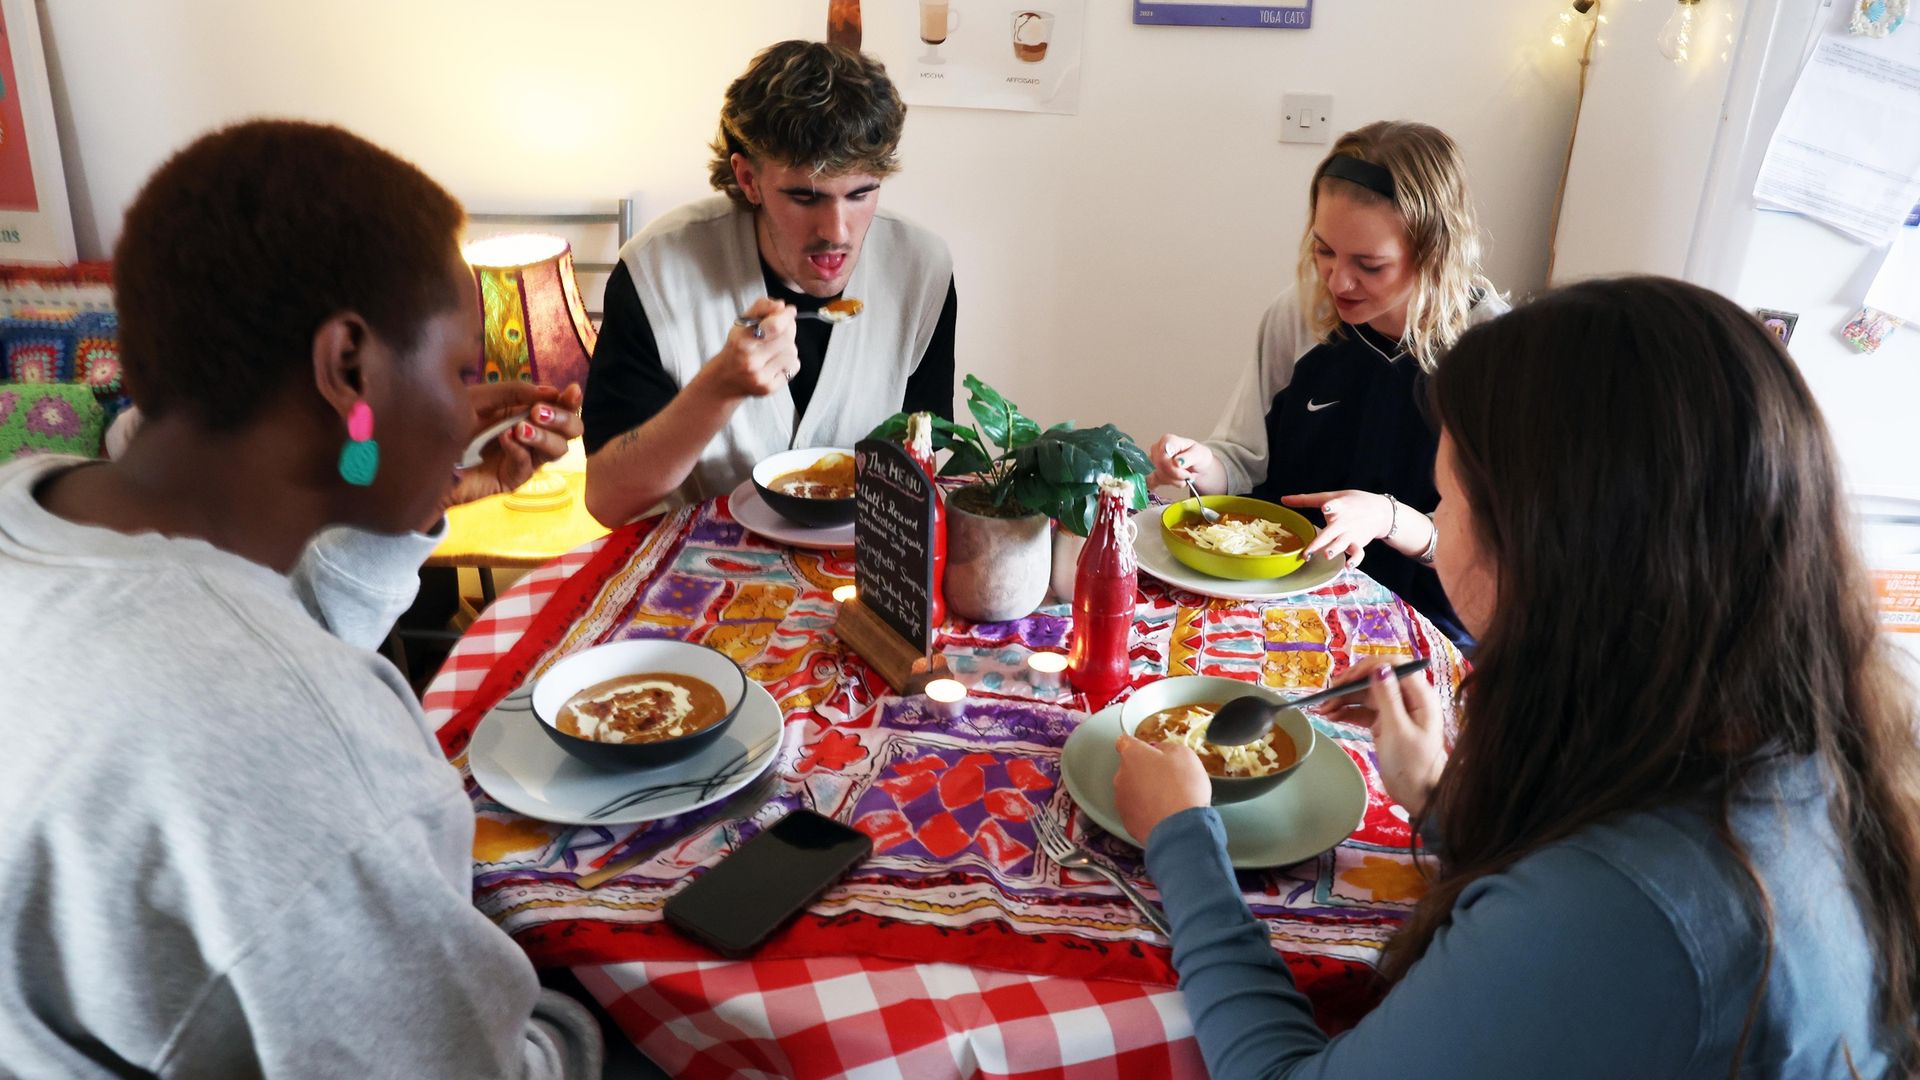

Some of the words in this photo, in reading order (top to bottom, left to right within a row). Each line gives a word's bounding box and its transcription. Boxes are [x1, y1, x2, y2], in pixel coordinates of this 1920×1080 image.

[1260, 10, 1281, 23] YOGA
[1284, 10, 1305, 25] CATS
[868, 452, 886, 476] The
[889, 462, 921, 493] MENU
